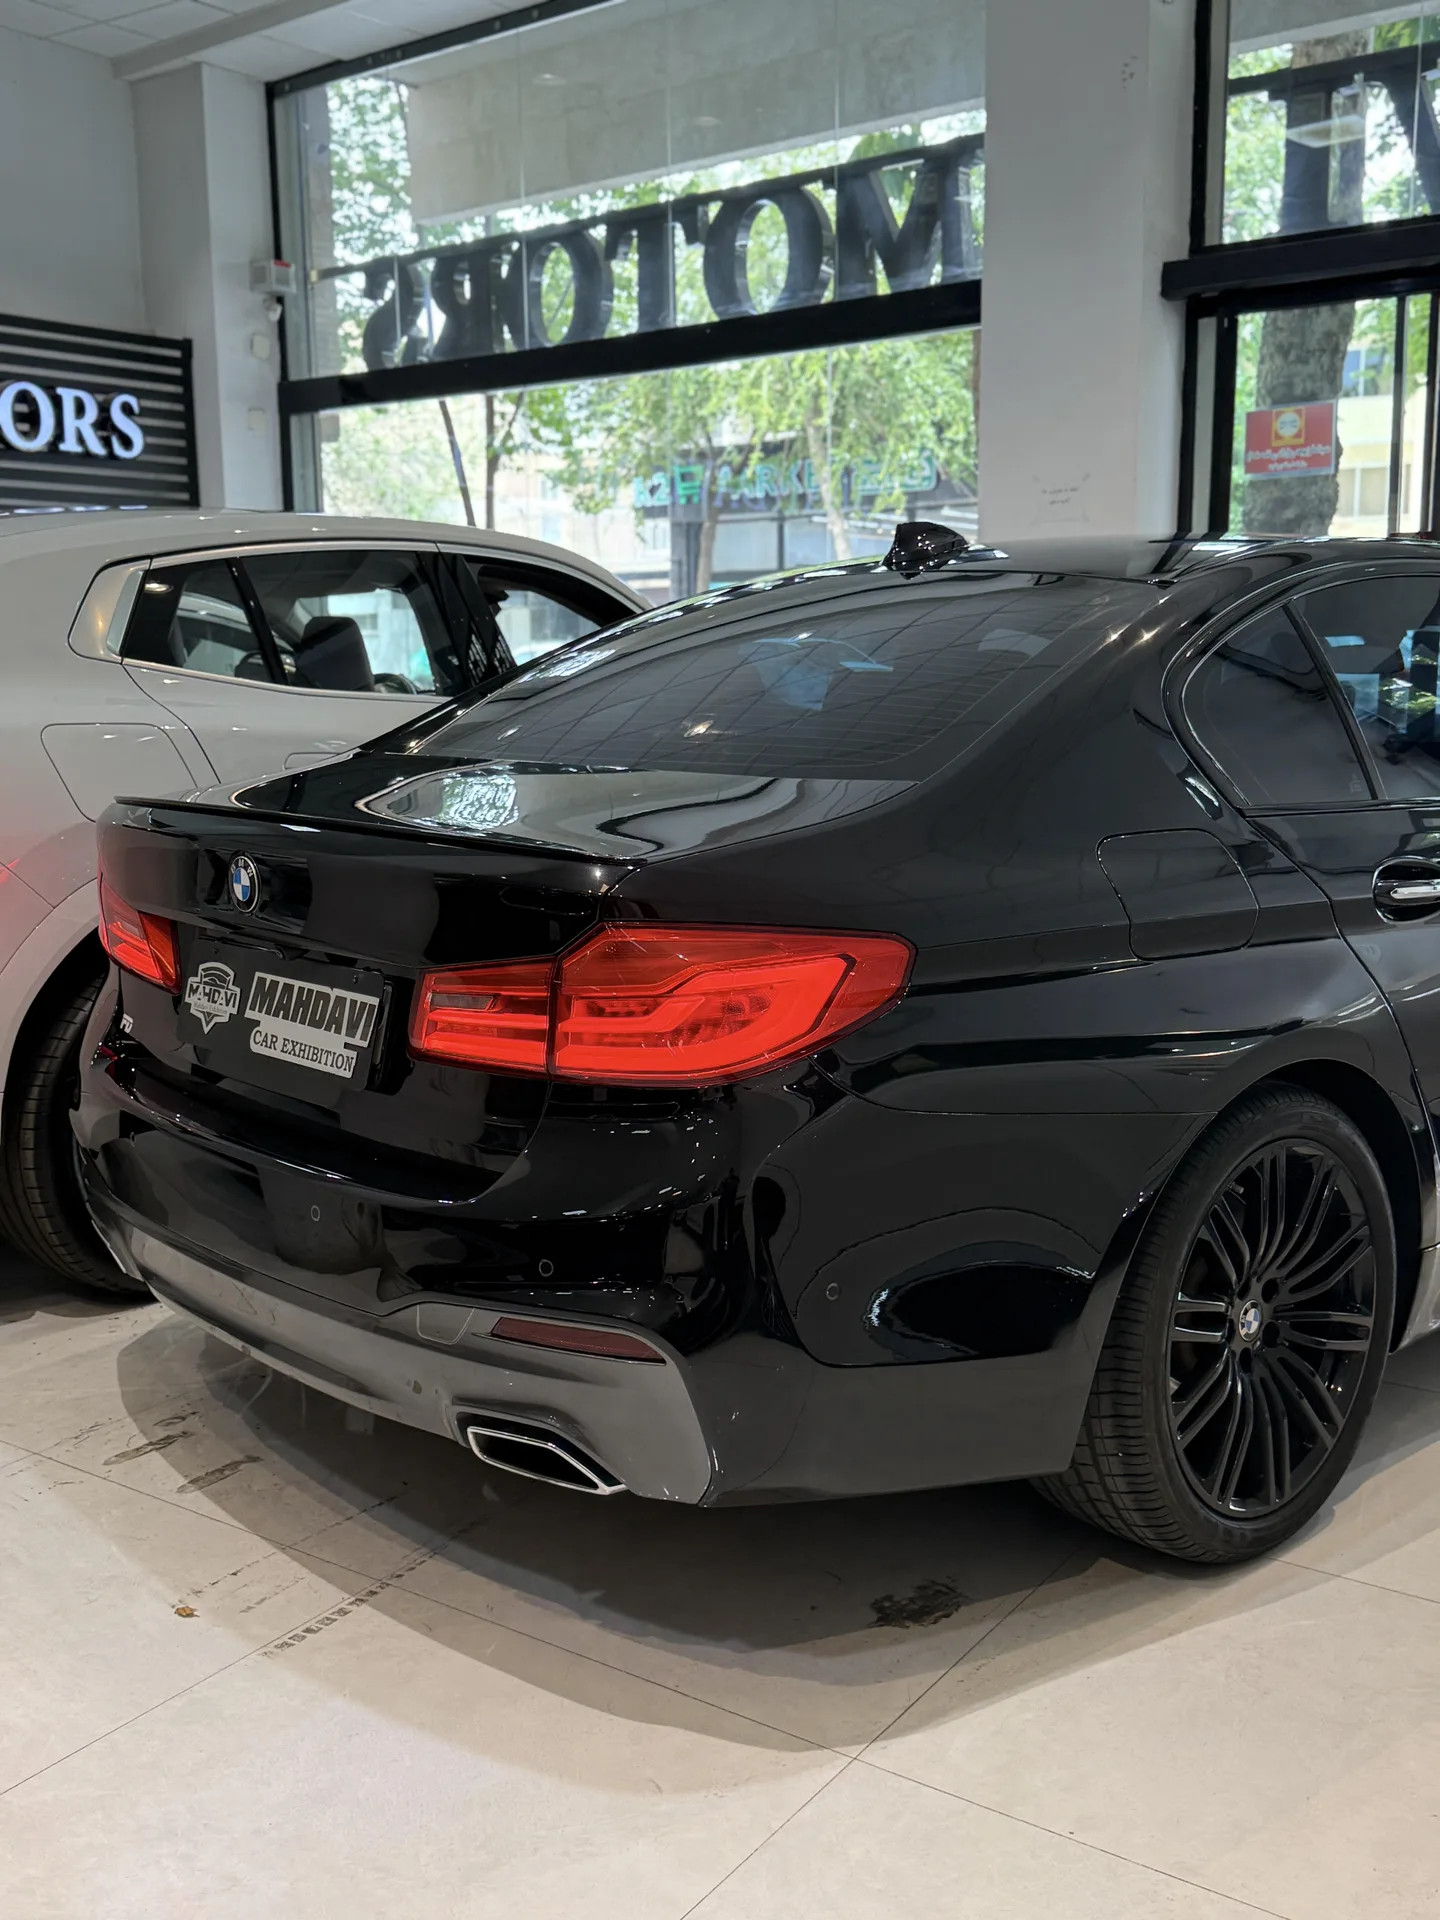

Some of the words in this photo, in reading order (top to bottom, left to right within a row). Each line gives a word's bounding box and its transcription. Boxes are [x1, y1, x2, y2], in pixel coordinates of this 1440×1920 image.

[0, 381, 144, 459] ORS
[187, 983, 238, 1009] MAHDAVI
[249, 976, 377, 1042] MAHDAVI
[253, 1029, 278, 1051] CAR
[282, 1038, 355, 1073] EXHIBITION
